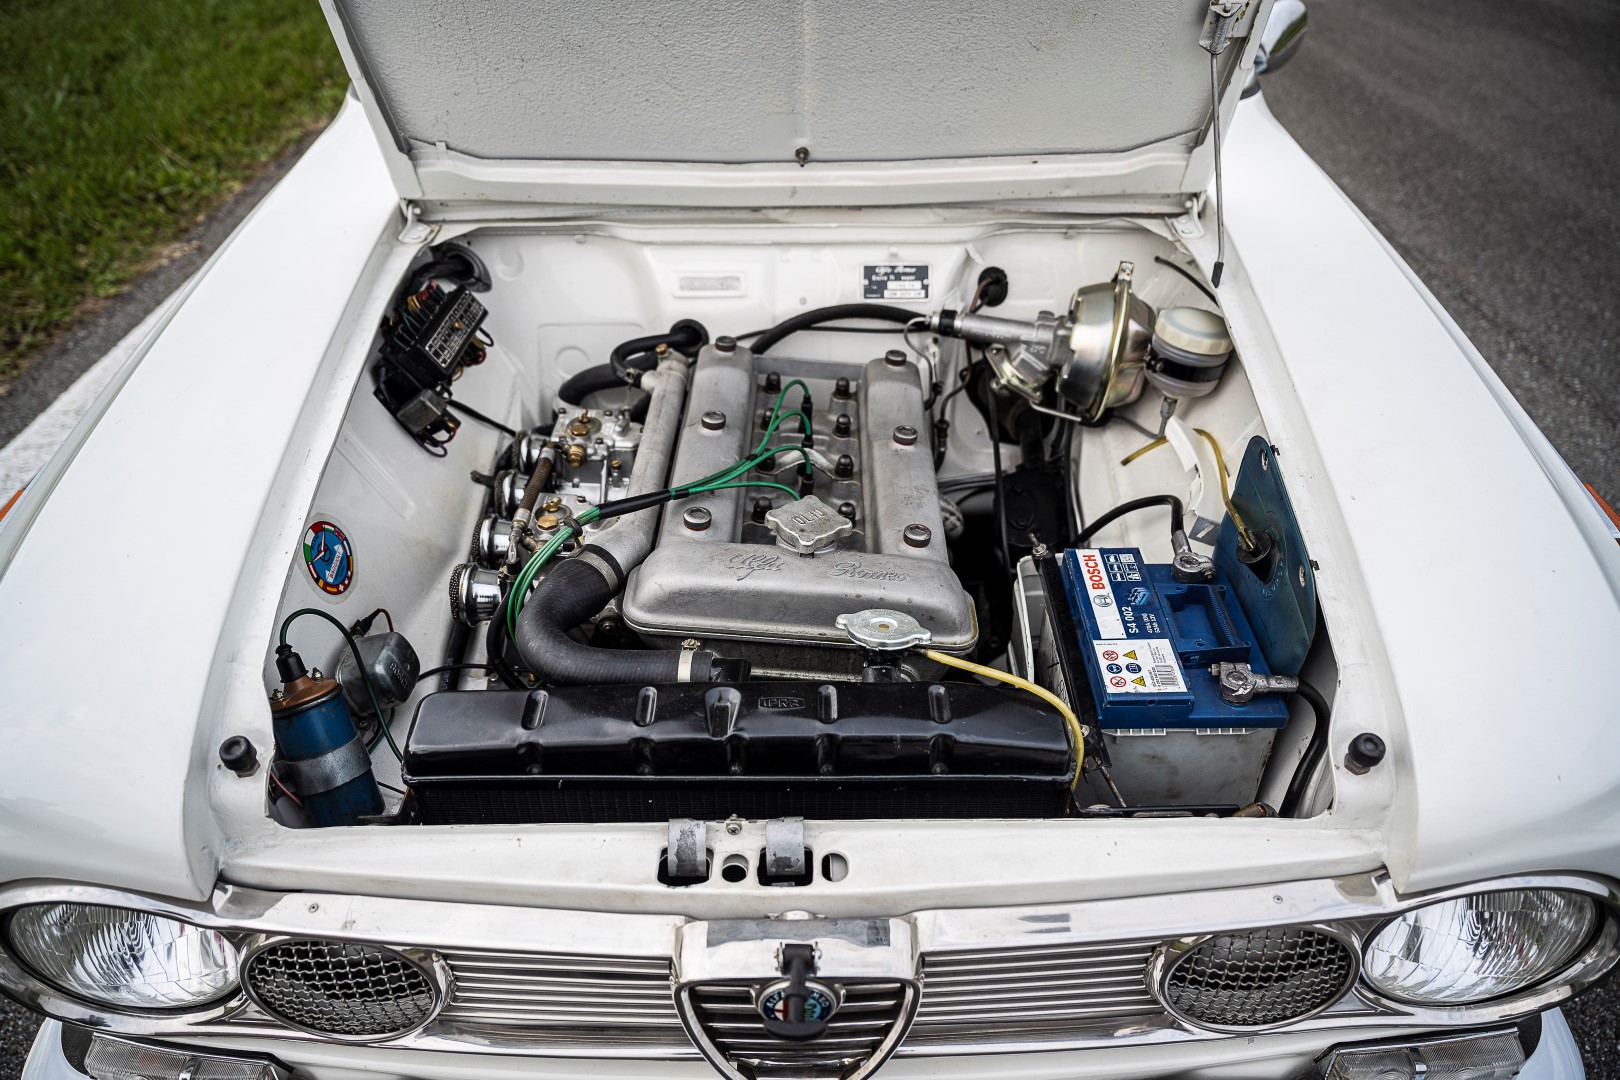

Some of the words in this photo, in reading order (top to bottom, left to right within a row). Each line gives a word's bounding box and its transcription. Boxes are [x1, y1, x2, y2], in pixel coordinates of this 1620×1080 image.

[724, 553, 785, 581] Alfa
[830, 561, 910, 582] Romeo
[1083, 554, 1105, 590] BOSCH
[1122, 606, 1134, 621] 002
[1127, 622, 1139, 634] S4
